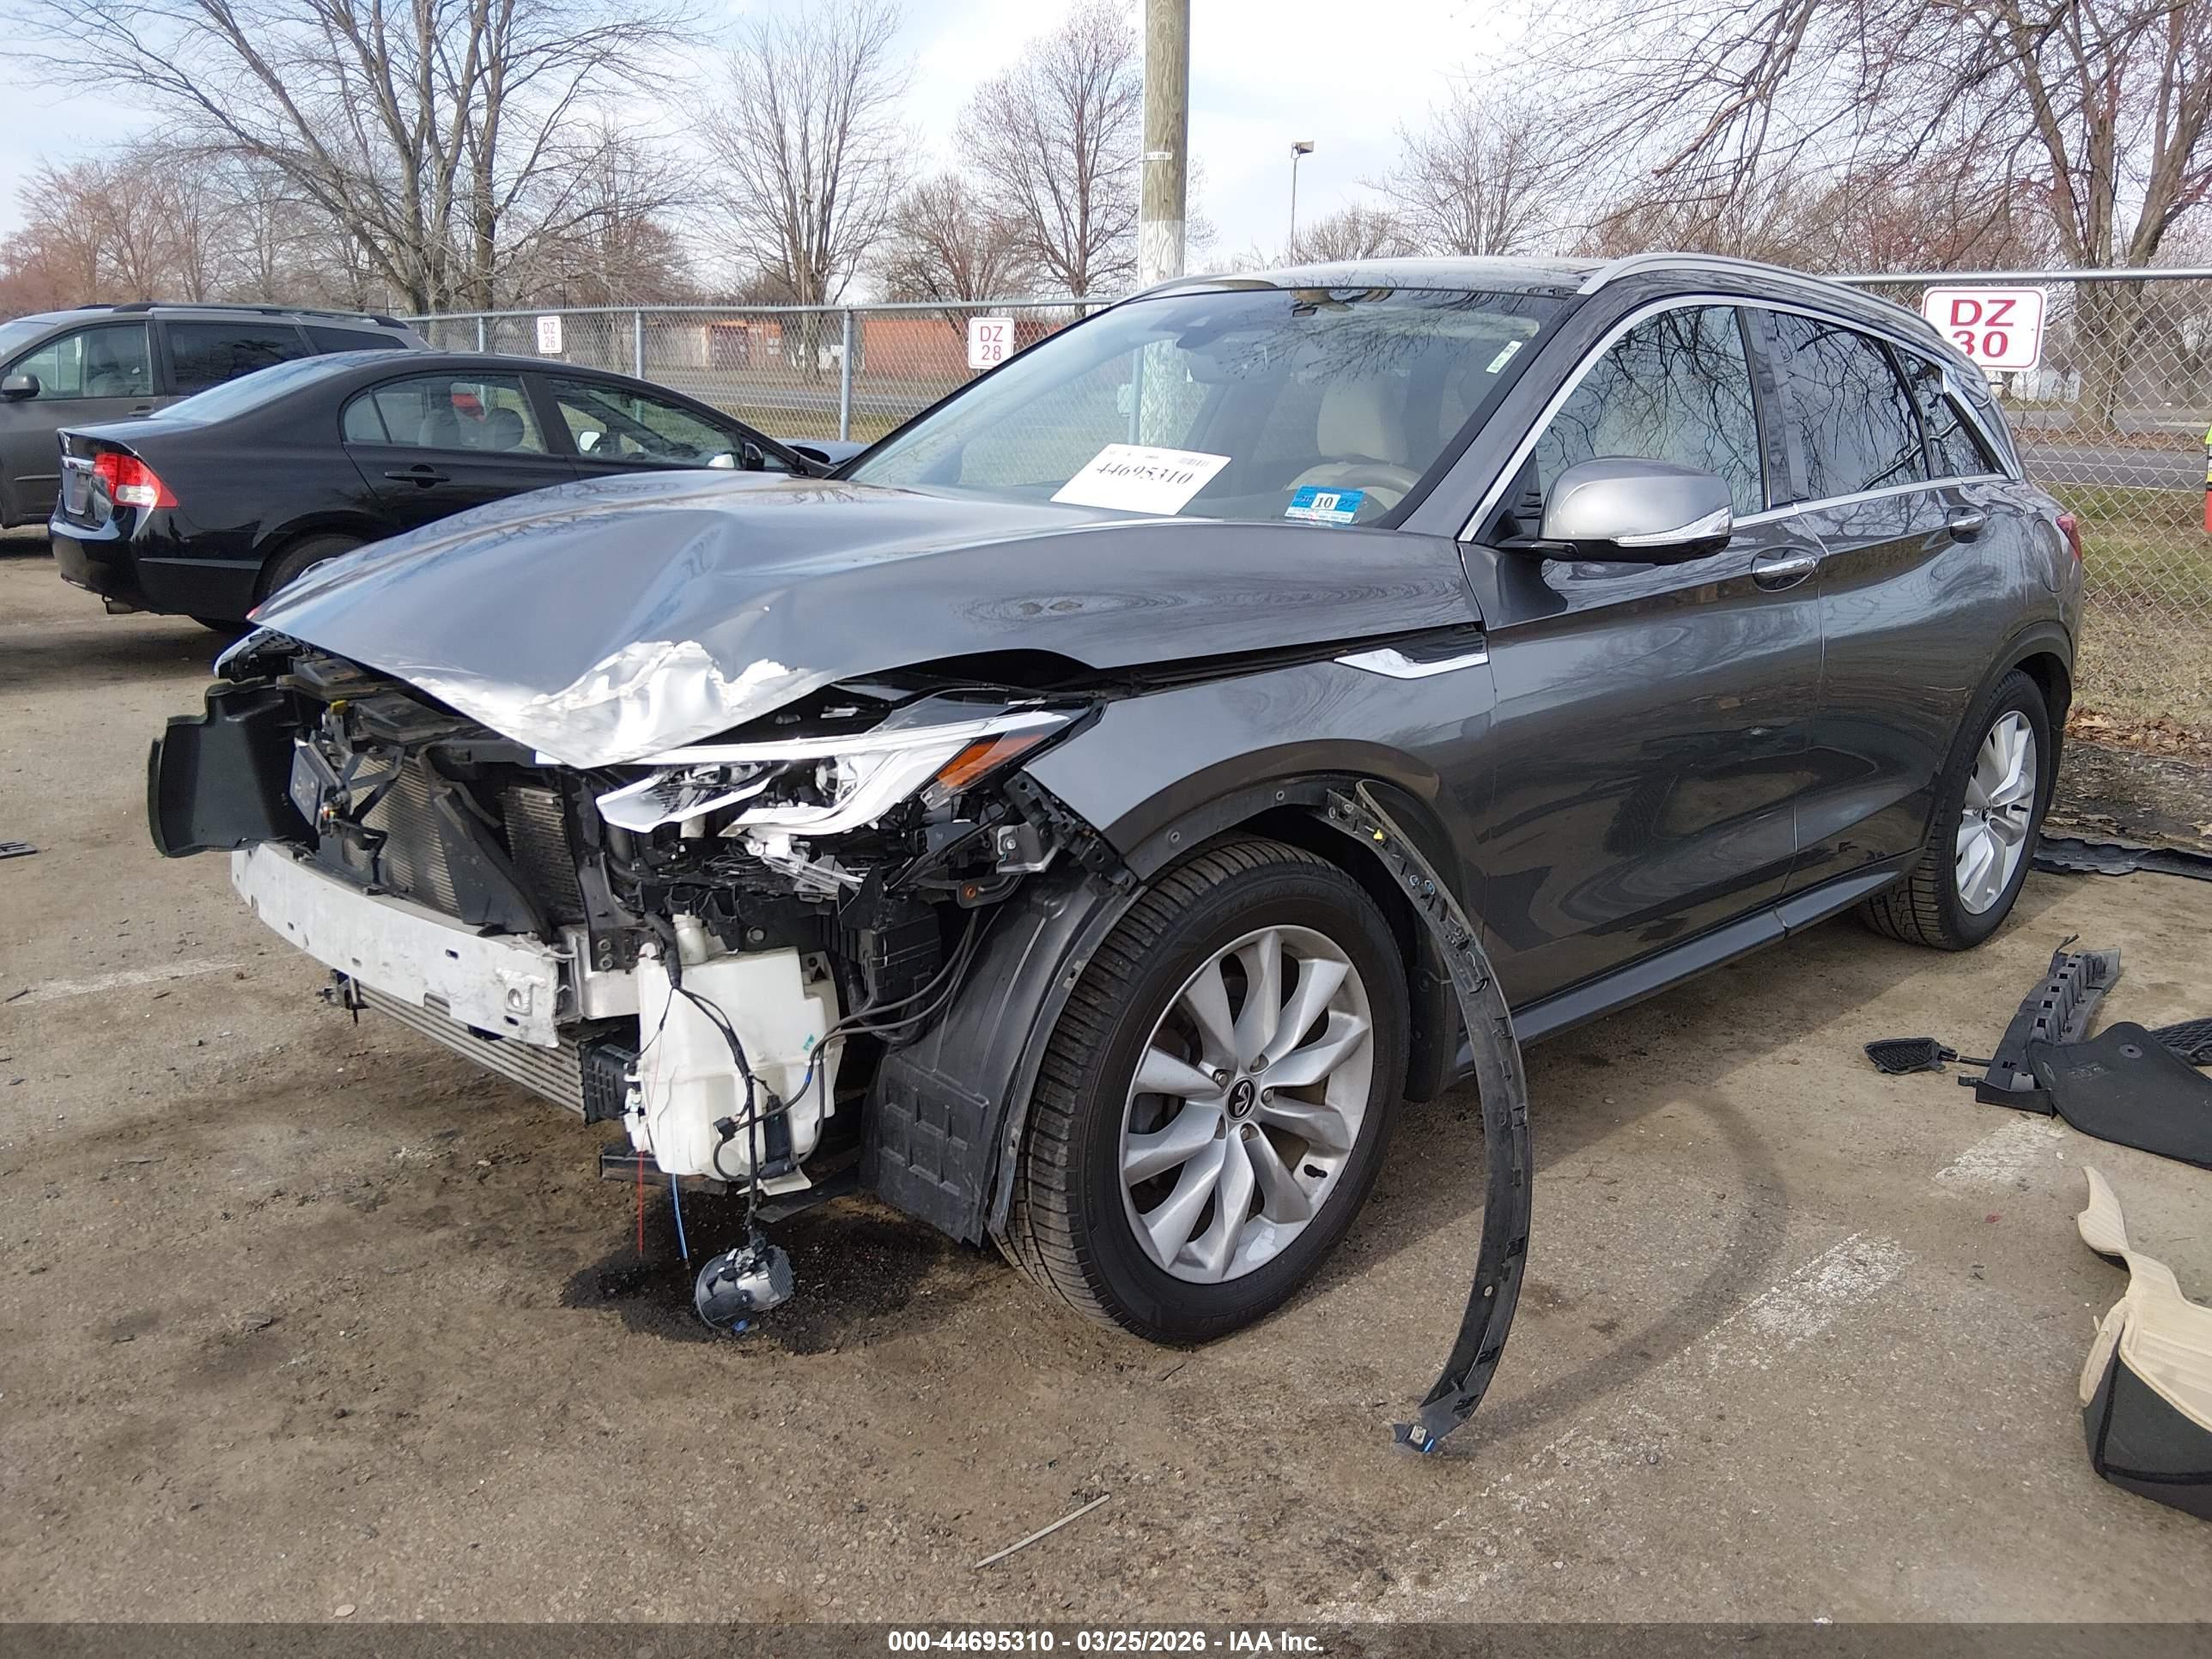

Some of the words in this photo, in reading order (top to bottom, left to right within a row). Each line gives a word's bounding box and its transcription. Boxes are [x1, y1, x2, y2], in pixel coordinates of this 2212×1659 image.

[1950, 299, 2016, 326] DZ
[543, 321, 556, 334] DZ
[980, 325, 1004, 342] DZ
[544, 336, 556, 348] 26
[1952, 330, 2008, 358] 30
[981, 344, 1001, 361] 28
[1097, 462, 1194, 484] 44695310
[1315, 496, 1334, 508] 10
